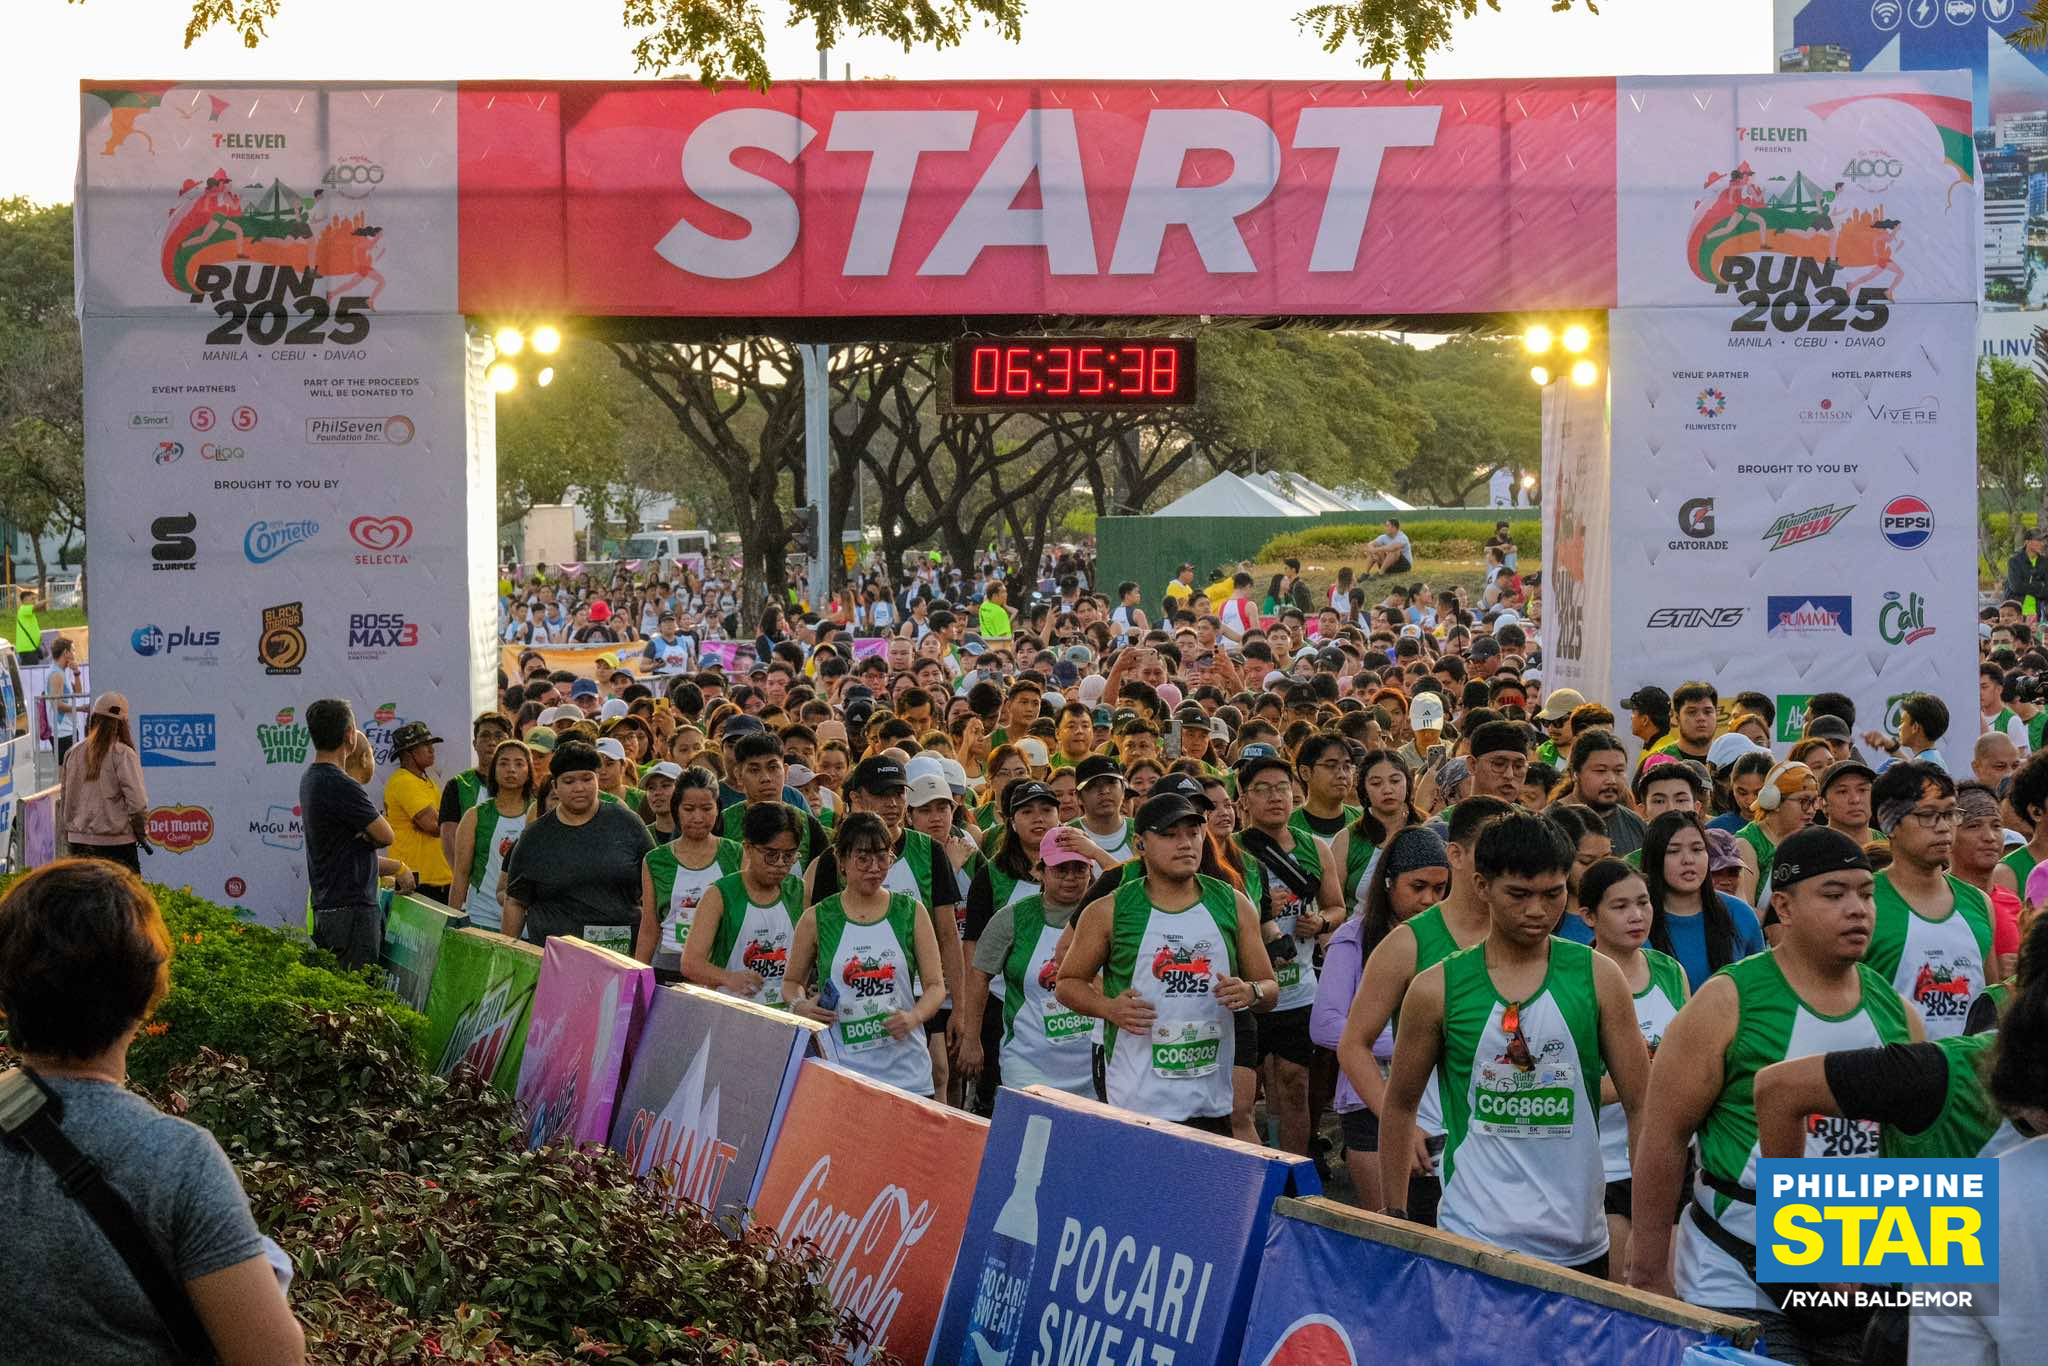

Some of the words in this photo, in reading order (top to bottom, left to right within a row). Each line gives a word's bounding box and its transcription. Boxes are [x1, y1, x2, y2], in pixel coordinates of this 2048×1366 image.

[212, 133, 286, 149] 7-ELEVEN
[1736, 127, 1807, 142] 7-ELEVEN
[654, 106, 1442, 280] START
[1715, 256, 1837, 294] RUN
[190, 264, 320, 304] RUN
[1730, 287, 1890, 332] 2025
[205, 295, 371, 345] 2025
[1728, 337, 1773, 348] MANILA
[1794, 337, 1828, 348] CEBU
[1845, 336, 1886, 347] DAVAO
[202, 350, 249, 361] MANILA
[271, 350, 306, 361] CEBU
[324, 349, 367, 361] DAVAO
[973, 347, 1177, 396] 06:35:38
[1672, 371, 1704, 379] VENUE
[1706, 371, 1750, 379] PARTNER
[1831, 371, 1862, 379] HOTEL
[1864, 370, 1912, 379] PARTNERS
[152, 385, 184, 394] EVENT
[186, 384, 237, 394] PARTNERS
[303, 378, 328, 387] PART
[330, 378, 345, 387] OF
[347, 378, 366, 386] THE
[368, 378, 420, 386] PROCEEDS
[310, 389, 334, 397] WILL
[336, 389, 349, 397] BE
[351, 389, 396, 397] DONATED
[397, 388, 414, 397] TO
[1799, 410, 1853, 420] CRIMSON
[1867, 404, 1937, 420] VIVERE
[143, 415, 169, 425] Smart
[312, 420, 382, 433] PhilSeven
[316, 433, 363, 442] Foundation
[364, 433, 381, 441] Inc.
[1737, 464, 1793, 474] BROUGHT
[1796, 464, 1813, 474] TO
[1815, 464, 1840, 474] YOU
[1842, 464, 1859, 473] BY
[214, 480, 273, 490] BROUGHT
[275, 480, 292, 489] TO
[295, 480, 321, 489] YOU
[323, 480, 339, 489] BY
[1884, 516, 1931, 529] PEPSI
[244, 519, 320, 565] Cornetto
[1668, 540, 1728, 550] GATORADE
[152, 562, 197, 571] SLURPEE
[354, 554, 409, 565] SELECTA
[350, 613, 404, 629] BOSS
[1646, 607, 1745, 629] STING
[1778, 611, 1841, 626] SUMMIT
[1878, 591, 1925, 646] Cali
[140, 630, 162, 651] sip
[166, 625, 221, 654] plus
[1117, 713, 1136, 721] JAPAN
[142, 723, 213, 736] POCARI
[256, 721, 310, 749] fruity
[142, 735, 206, 748] SWEAT
[263, 746, 307, 765] zing
[150, 819, 168, 833] Del
[170, 819, 209, 833] Monte
[851, 978, 881, 989] RUN
[1160, 971, 1194, 983] RUN
[855, 983, 895, 998] 2025
[1166, 980, 1209, 994] 2025
[1925, 1001, 1969, 1017] 2025
[1813, 1118, 1858, 1138] RUN
[1822, 1130, 1879, 1157] 2025
[979, 1266, 1026, 1308] POCARI
[1049, 1216, 1214, 1344] POCARI
[974, 1295, 1017, 1336] SWEAT
